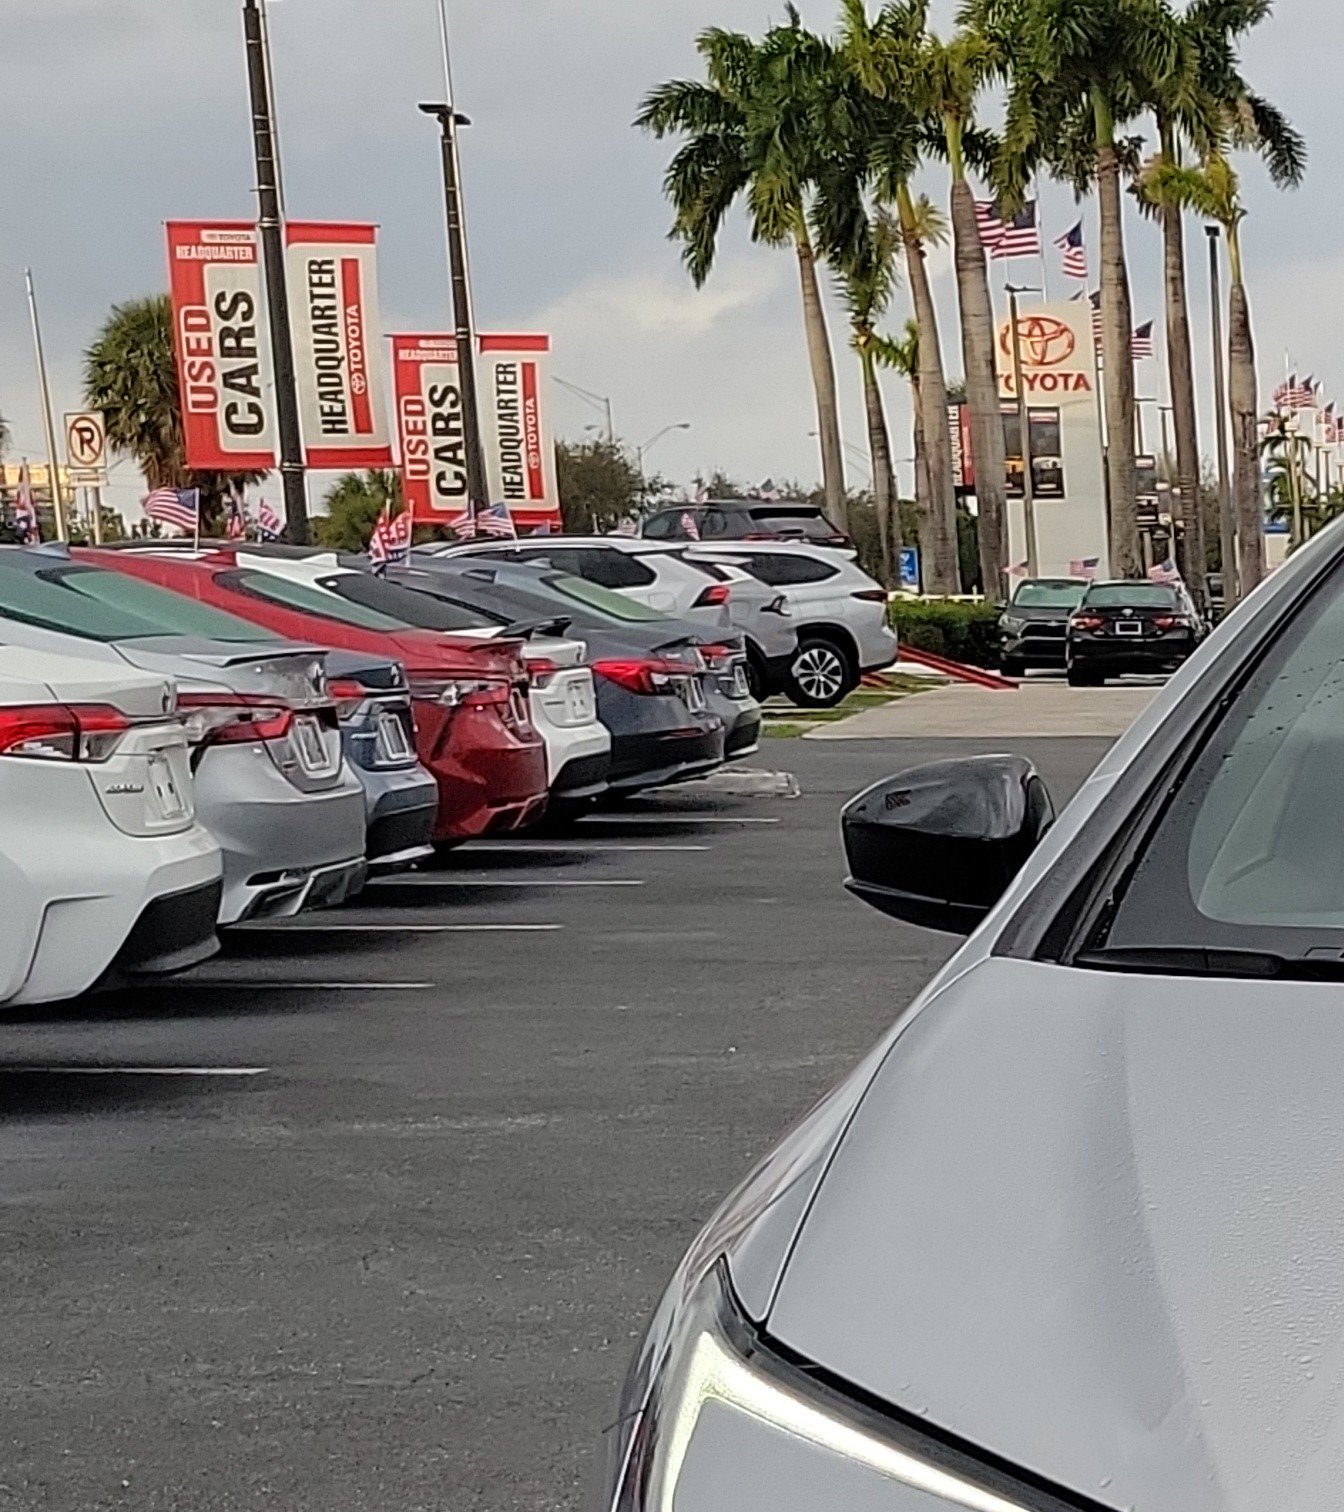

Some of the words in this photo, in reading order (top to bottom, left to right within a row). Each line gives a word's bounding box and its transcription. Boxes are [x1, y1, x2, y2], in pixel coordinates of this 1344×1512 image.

[180, 305, 220, 413] USED
[214, 290, 265, 436] CARS
[308, 258, 349, 435] HEADQUARTER
[347, 305, 365, 371] TOYOTA
[401, 396, 431, 480] USED
[428, 385, 467, 497] CARS
[495, 363, 526, 500] HEADQUARTER
[526, 398, 539, 450] TOYOTA
